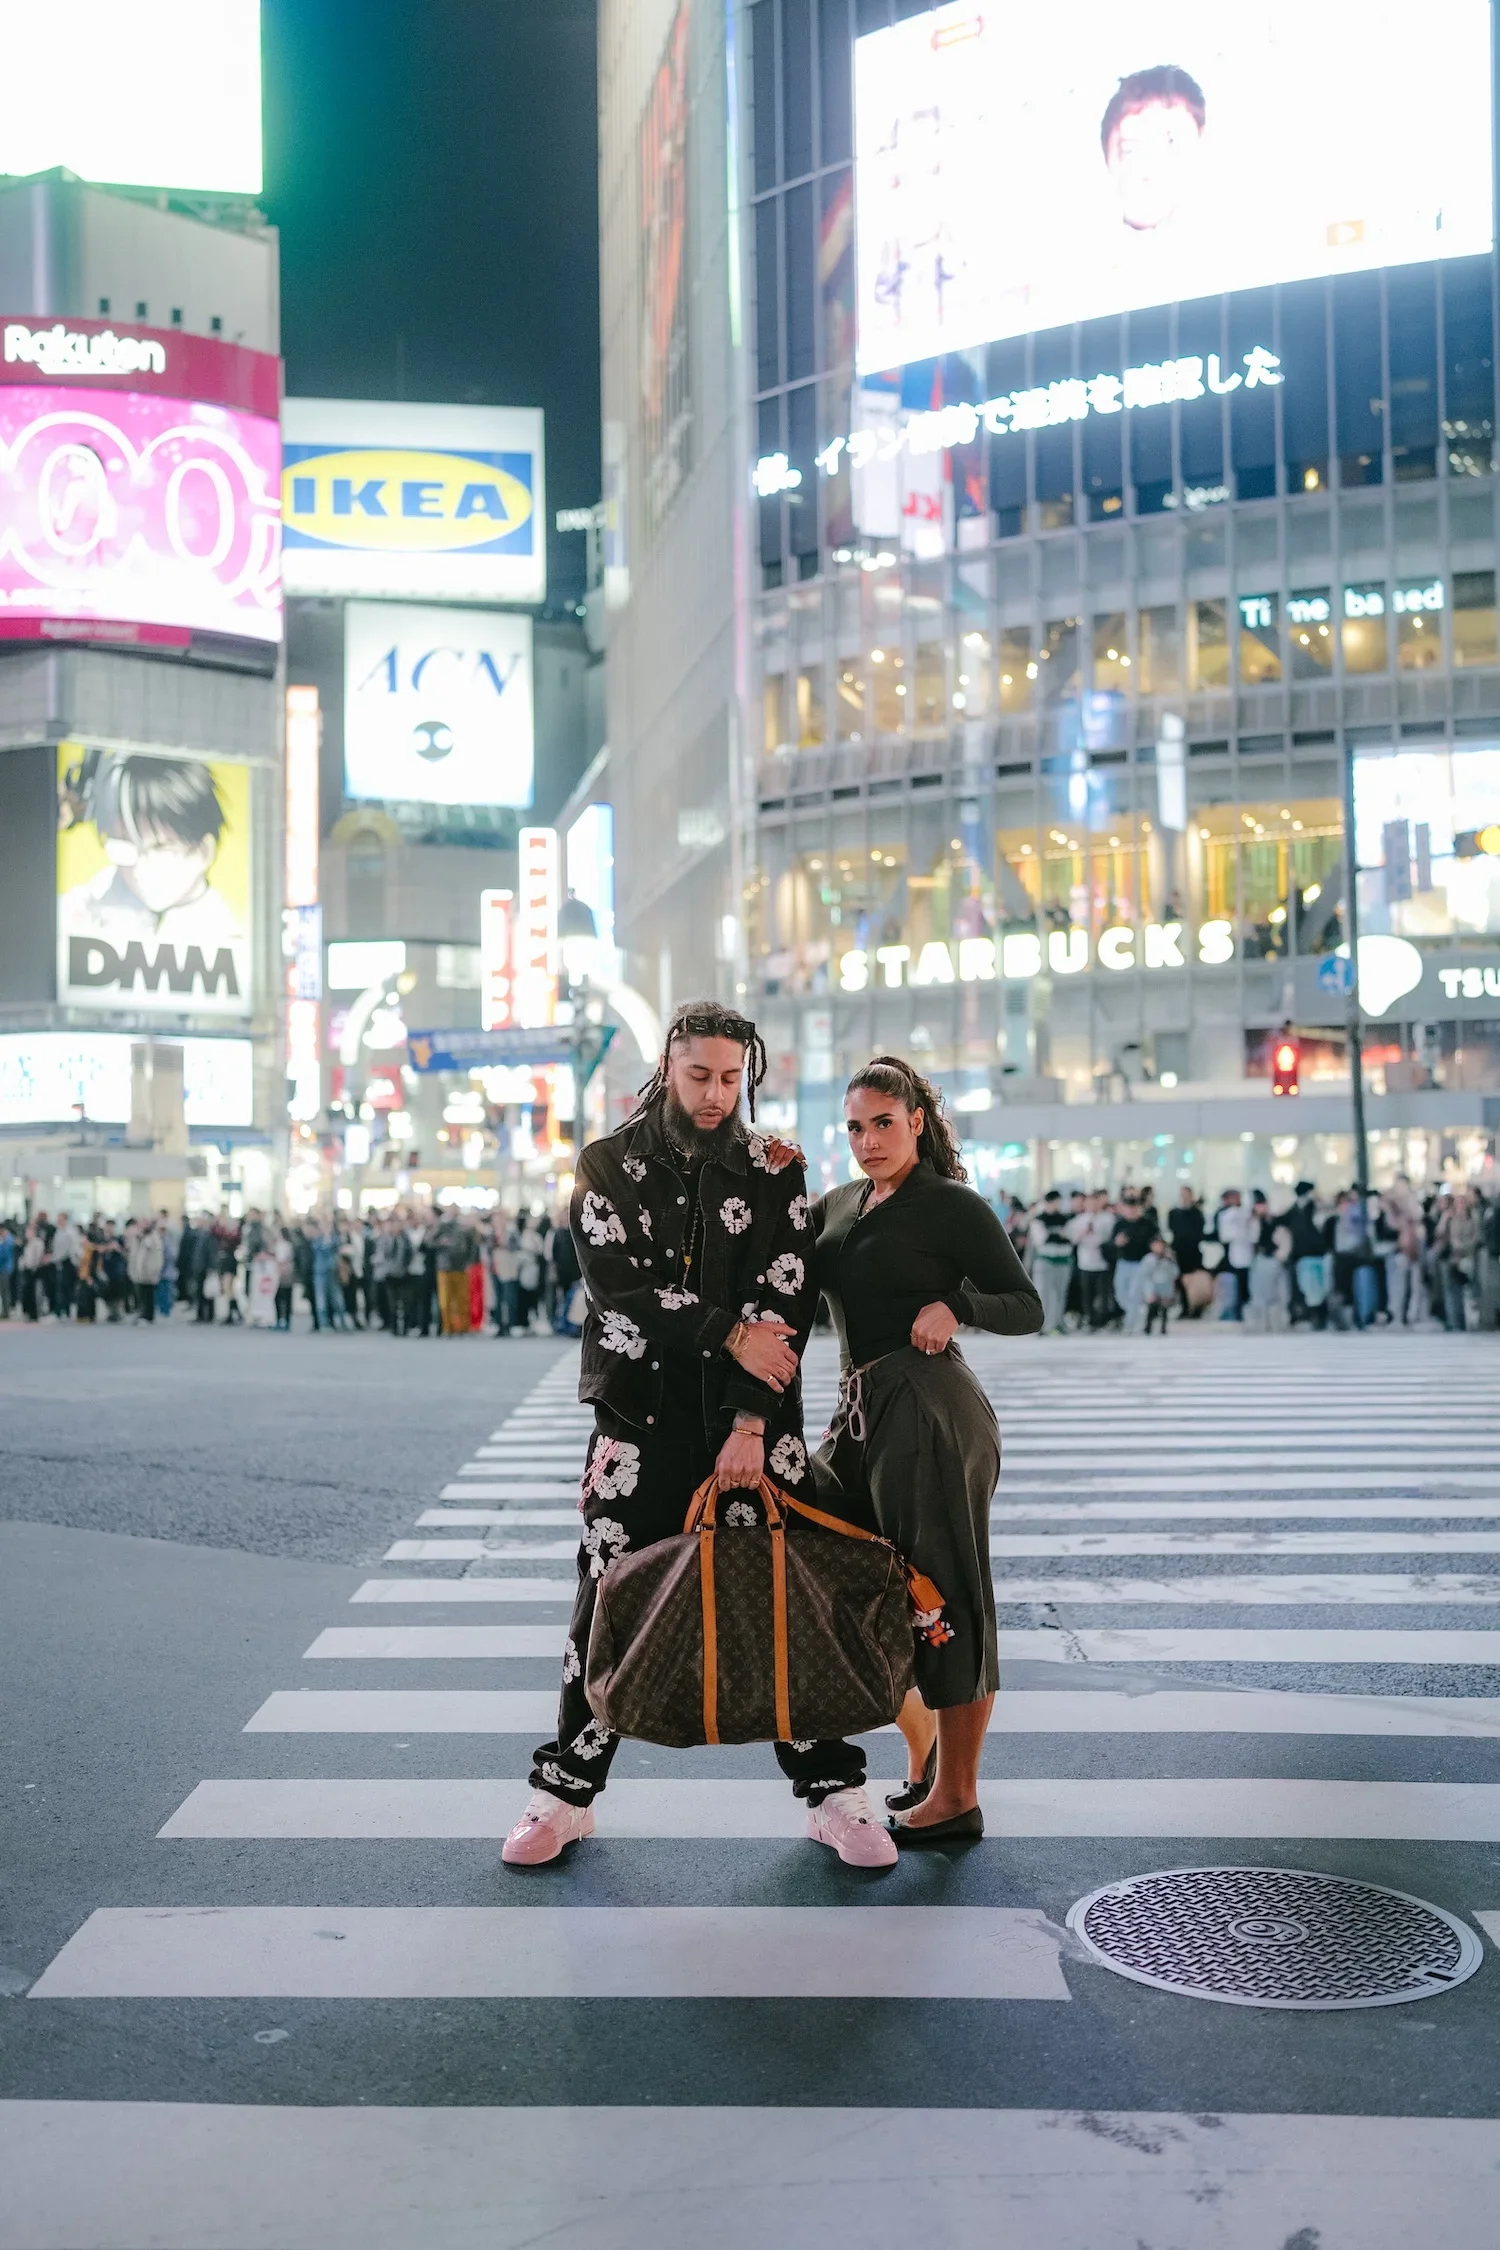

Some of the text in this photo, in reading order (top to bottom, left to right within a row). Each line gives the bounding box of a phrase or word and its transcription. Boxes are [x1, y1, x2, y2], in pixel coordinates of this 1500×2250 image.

[4, 324, 166, 374] Rakuten
[292, 477, 509, 521] IKEA
[356, 643, 523, 697] ACN
[69, 935, 239, 995] DMM
[839, 919, 1235, 992] STARBUCKS
